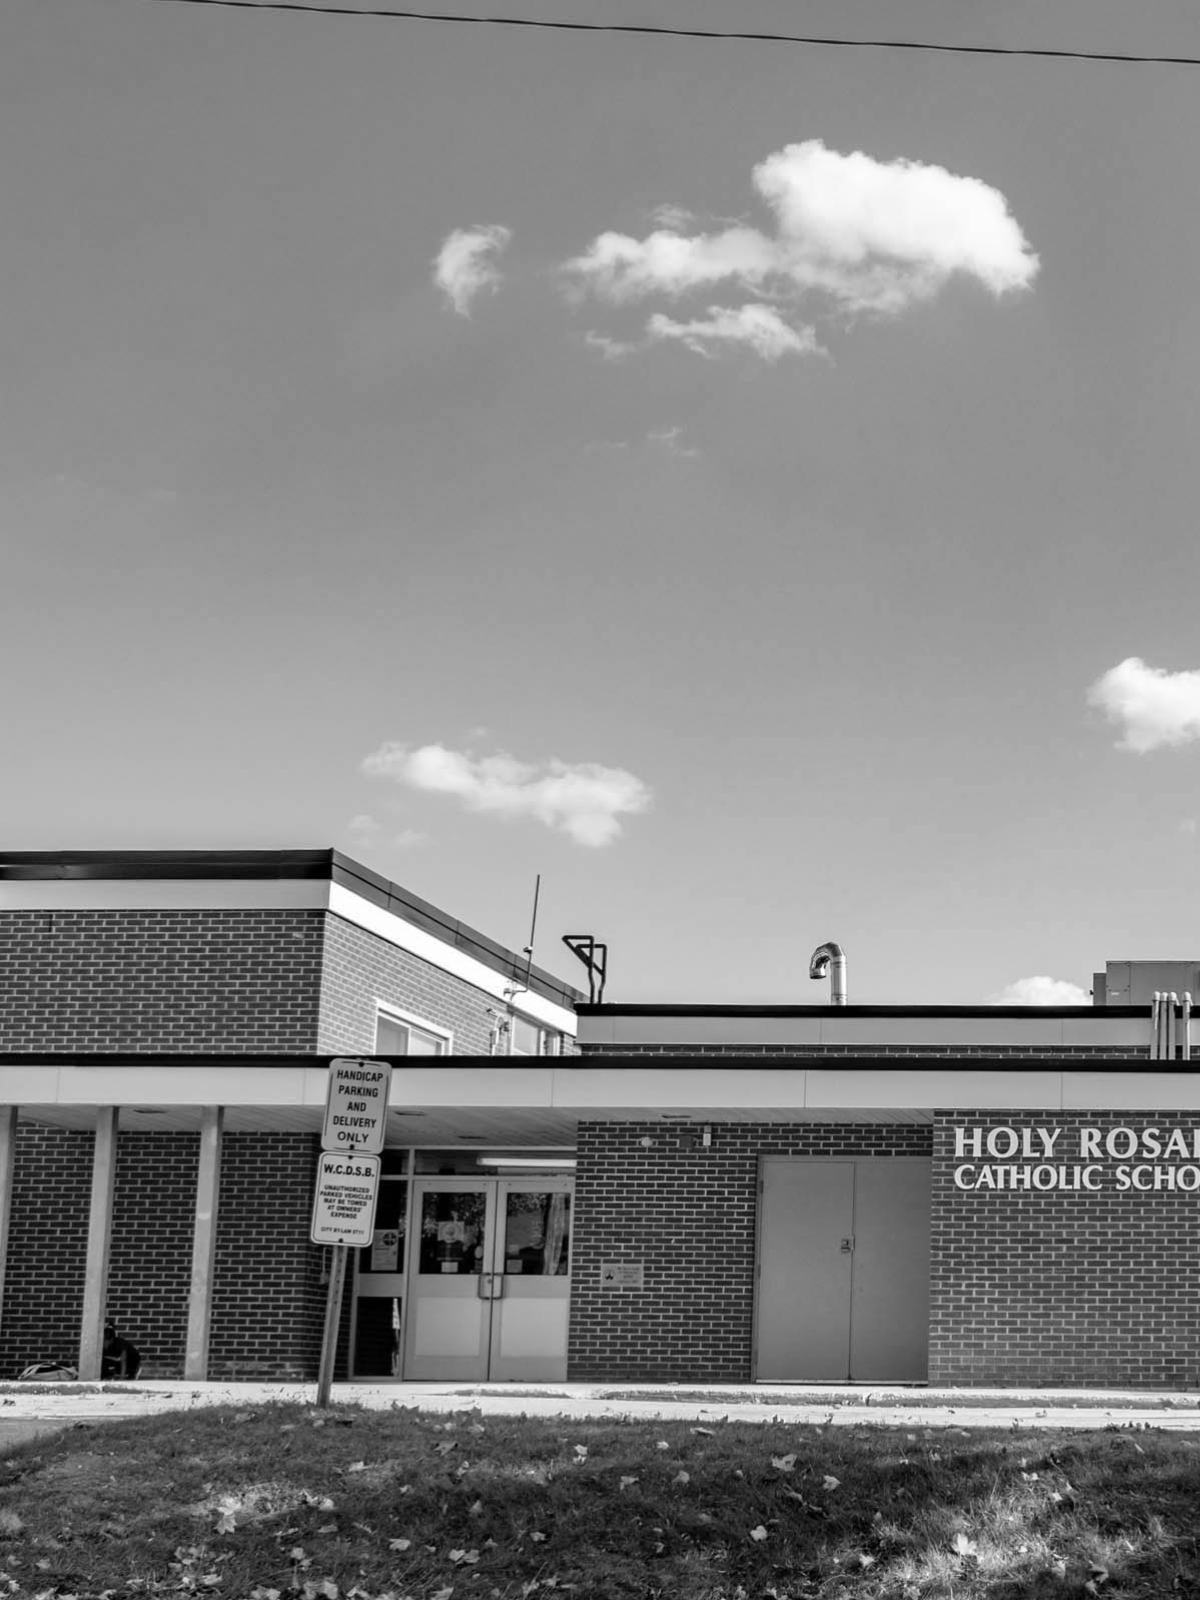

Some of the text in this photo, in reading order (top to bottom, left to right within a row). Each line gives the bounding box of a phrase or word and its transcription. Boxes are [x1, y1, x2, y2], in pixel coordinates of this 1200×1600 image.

[337, 1069, 384, 1082] HANDICAP
[338, 1084, 379, 1098] PARKING
[346, 1101, 367, 1112] AND
[333, 1115, 377, 1129] DELIVERY
[337, 1131, 369, 1143] ONLY
[955, 1127, 1062, 1158] HOLY
[324, 1163, 375, 1178] W.C.D.S.B.
[953, 1164, 1104, 1190] CATHOLIC
[320, 1190, 343, 1198] PARKED
[324, 1185, 370, 1194] UNAUTHORIZED
[330, 1211, 357, 1219] EXPENSE
